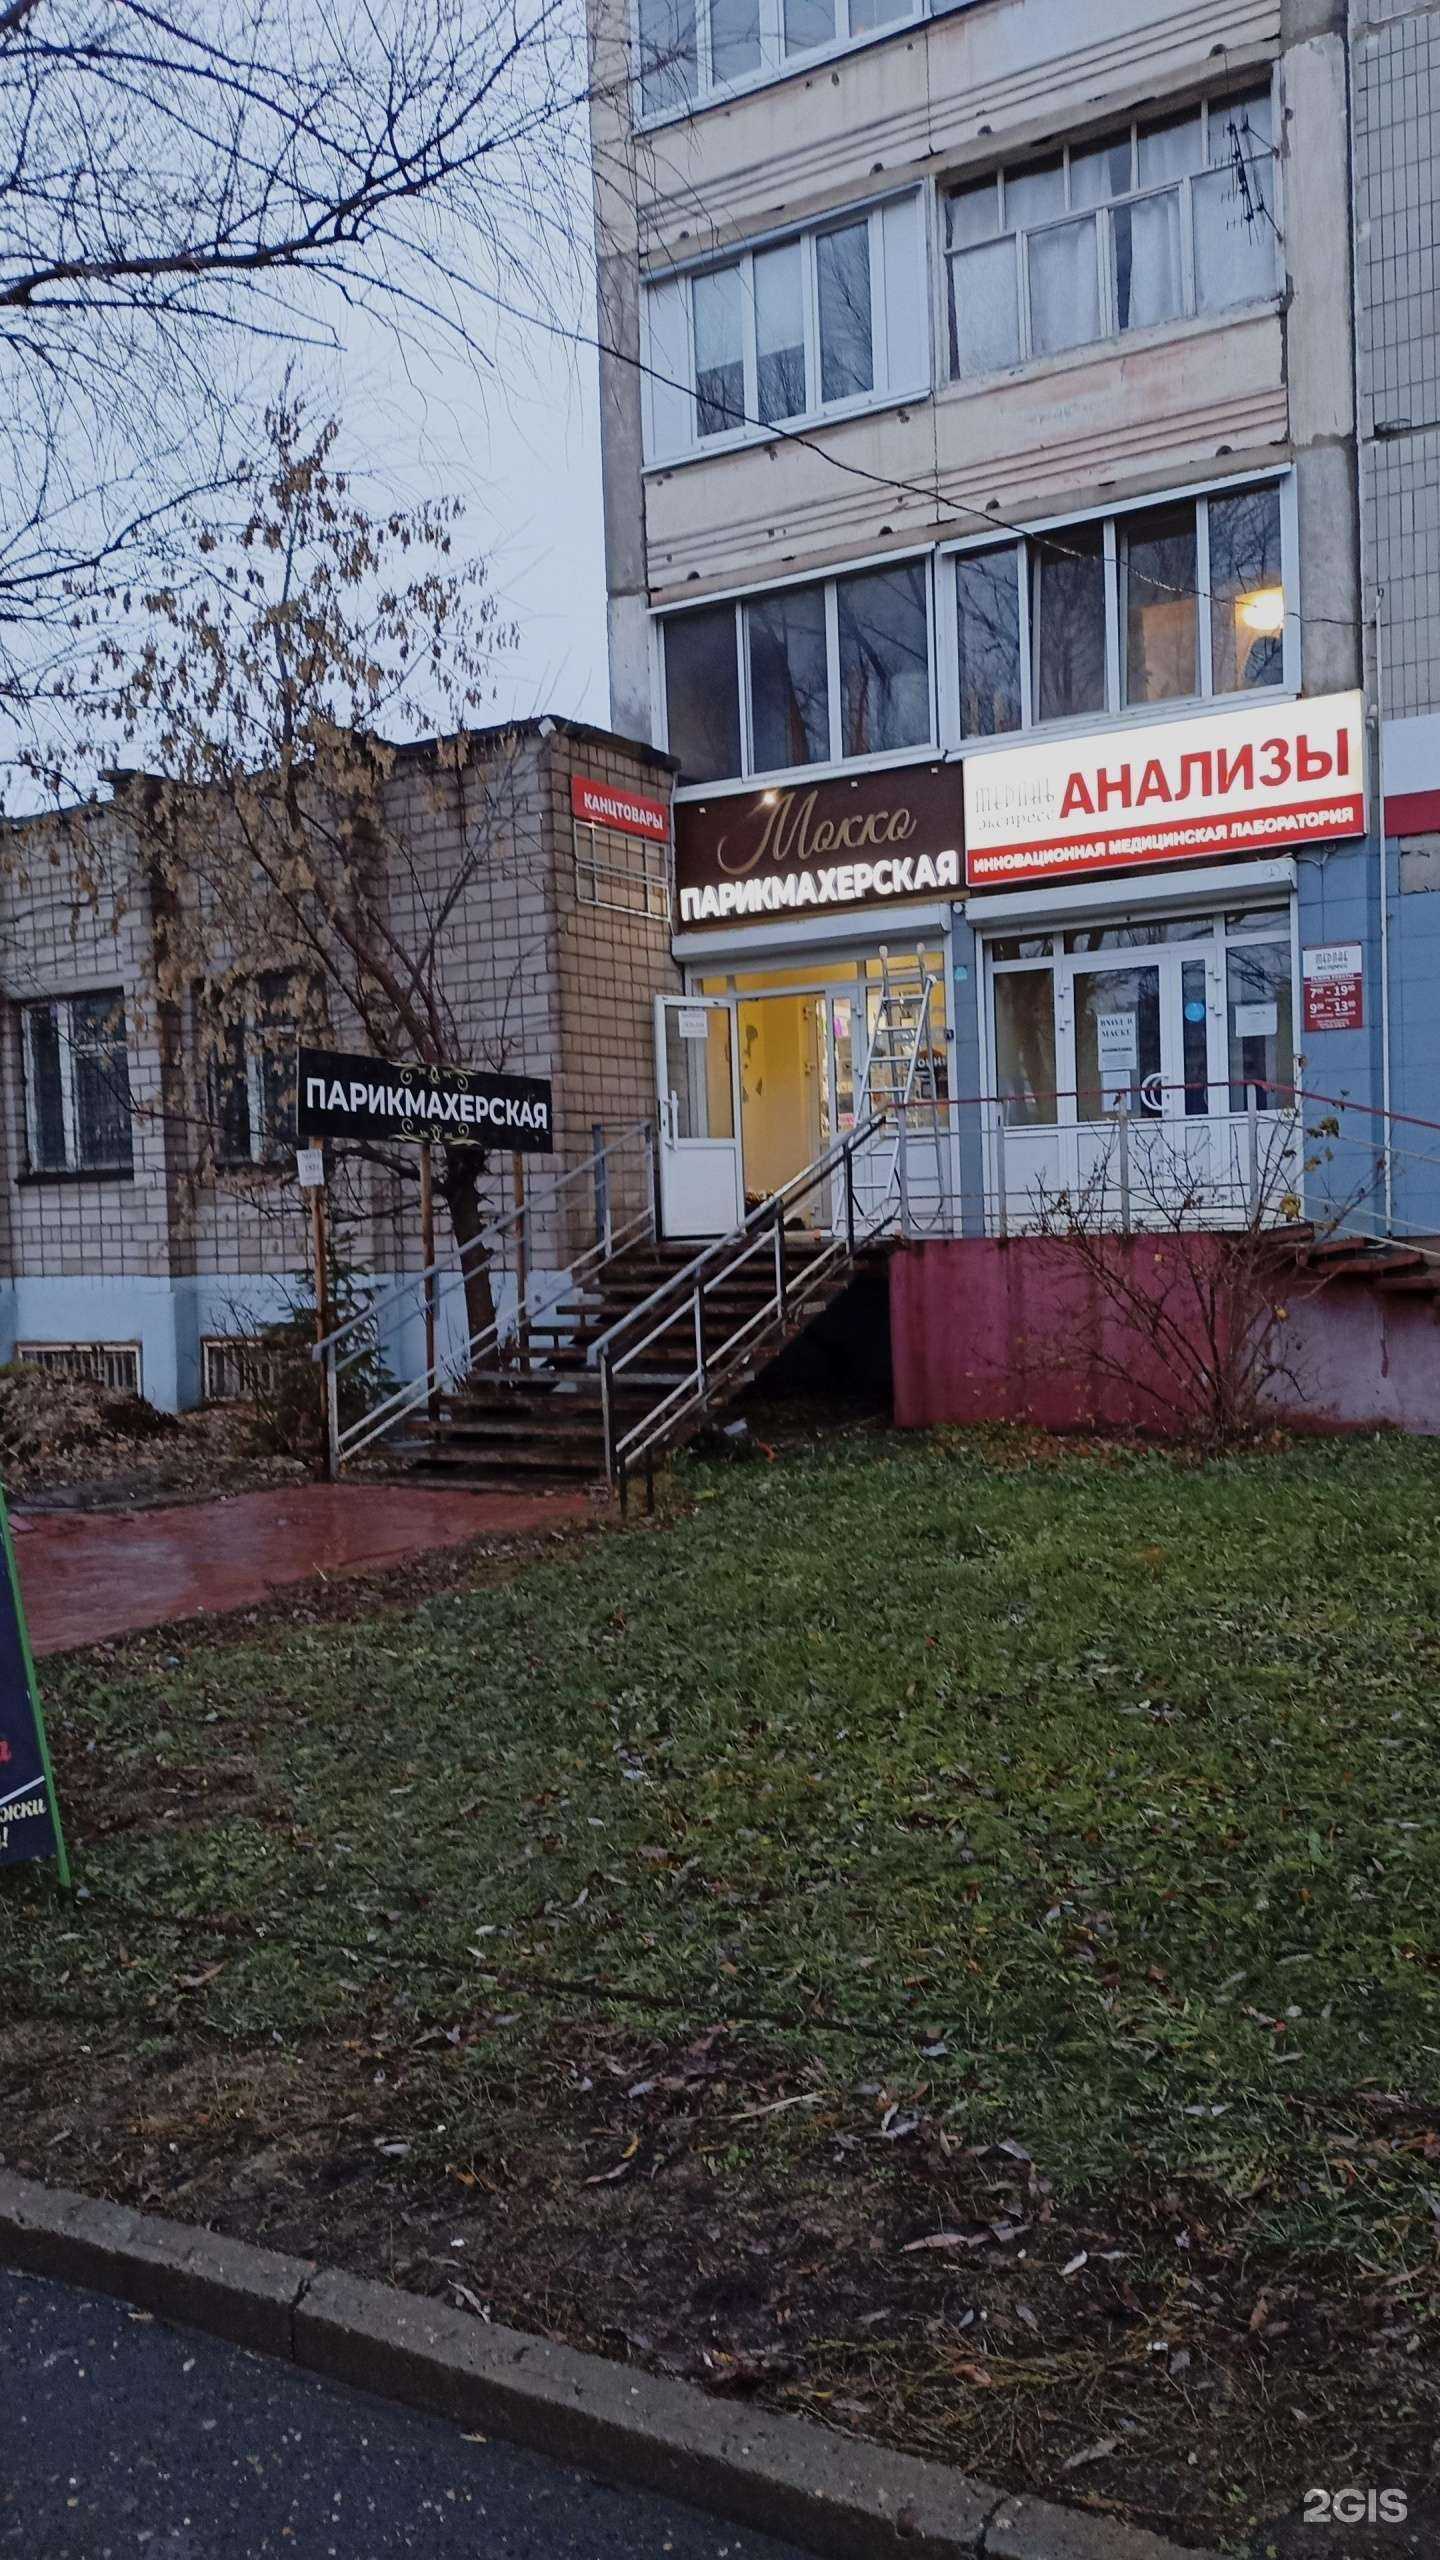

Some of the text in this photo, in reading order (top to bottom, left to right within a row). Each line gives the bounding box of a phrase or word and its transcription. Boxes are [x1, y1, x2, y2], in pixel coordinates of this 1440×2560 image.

[1059, 727, 1350, 819] АНАЛИЗЫ
[583, 791, 664, 831] КАНЦТОВАРЫ
[717, 788, 917, 876] Мокко
[973, 805, 1354, 875] ИННОВАЦИОННАЯ МЕДИЦИНСКАЯ ЛАБОРАТОРИЯ
[679, 850, 960, 922] ПАРИКМАХЕРСКАЯ
[305, 1076, 548, 1130] ПАРИКМАХЕРСКАЯ
